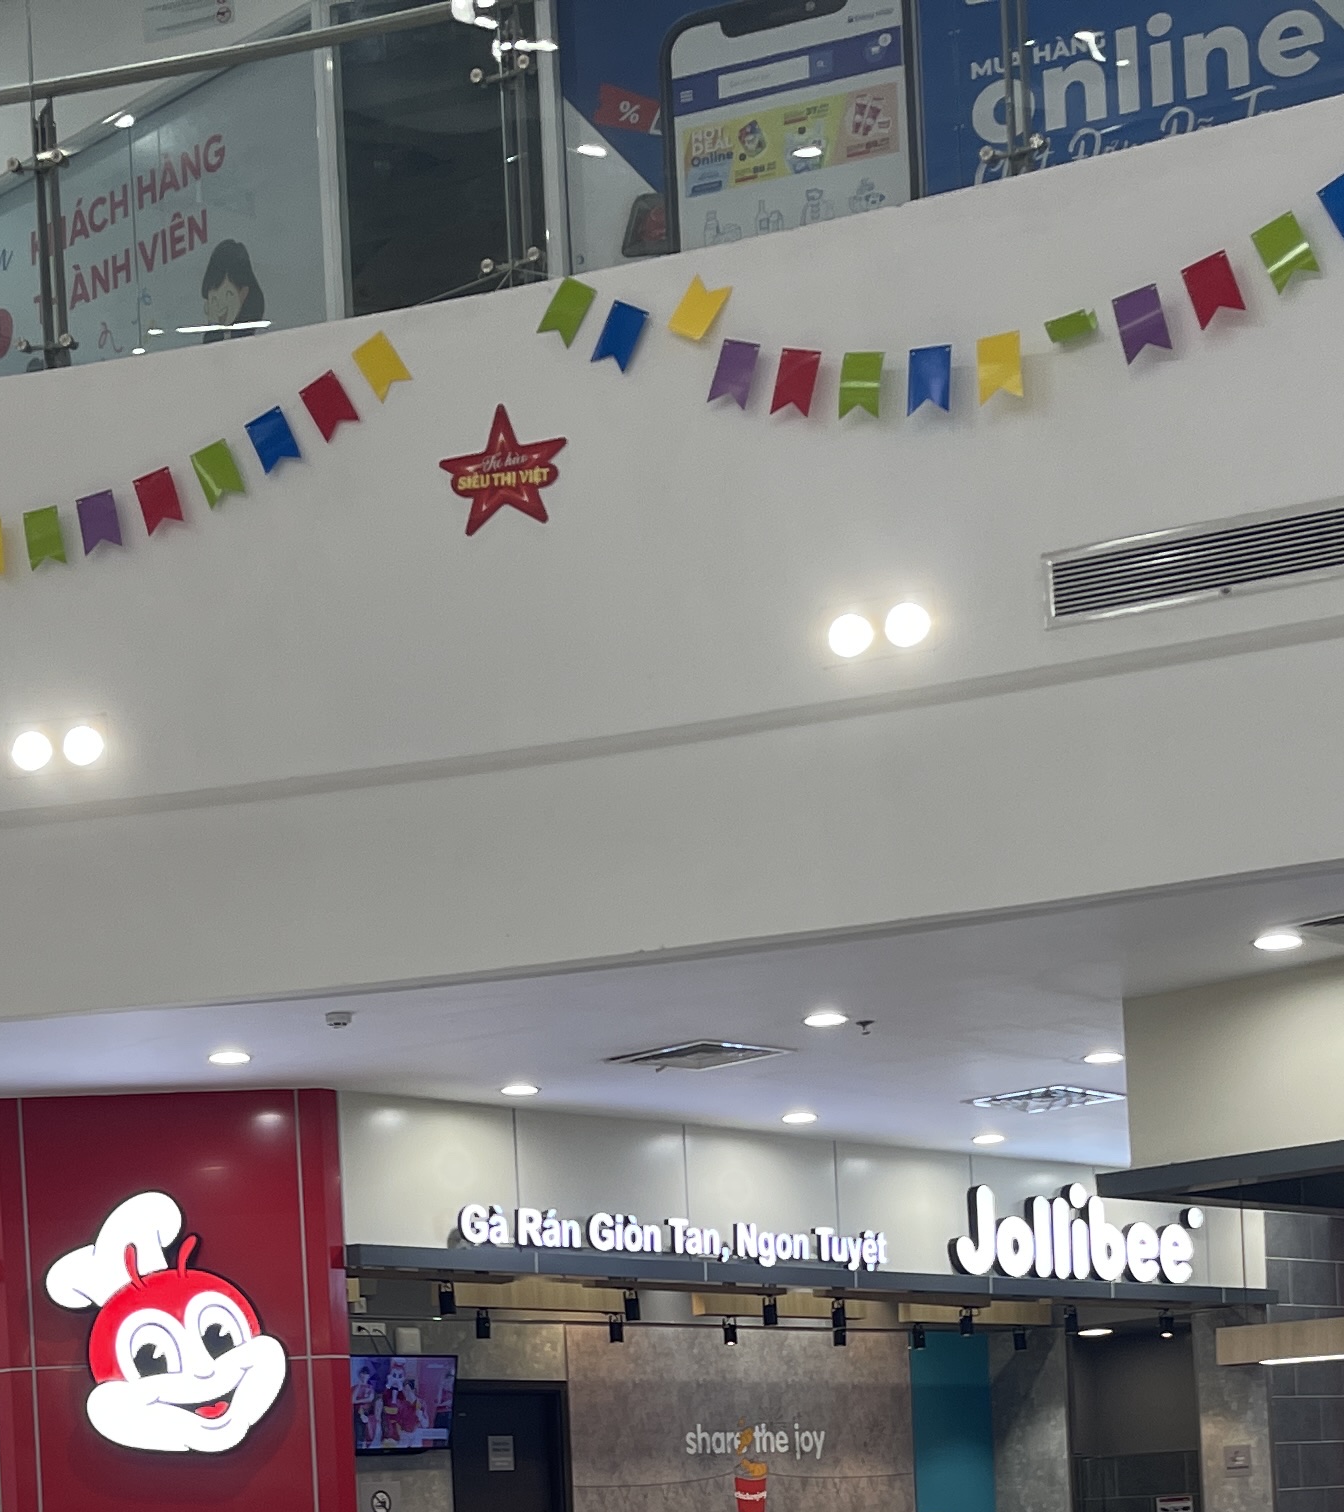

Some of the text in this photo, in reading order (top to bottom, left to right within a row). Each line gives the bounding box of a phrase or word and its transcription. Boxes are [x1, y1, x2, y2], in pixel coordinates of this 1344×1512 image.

[971, 9, 1326, 145] online
[137, 133, 226, 210] HÀNG
[691, 151, 734, 167] Online
[34, 209, 208, 325] ÀNH VIÊN
[460, 1204, 888, 1271] Gà Rán Giòn Tan, Ngon Tuyệt
[950, 1182, 1196, 1284] Jollibee
[685, 1423, 826, 1460] share the joy
